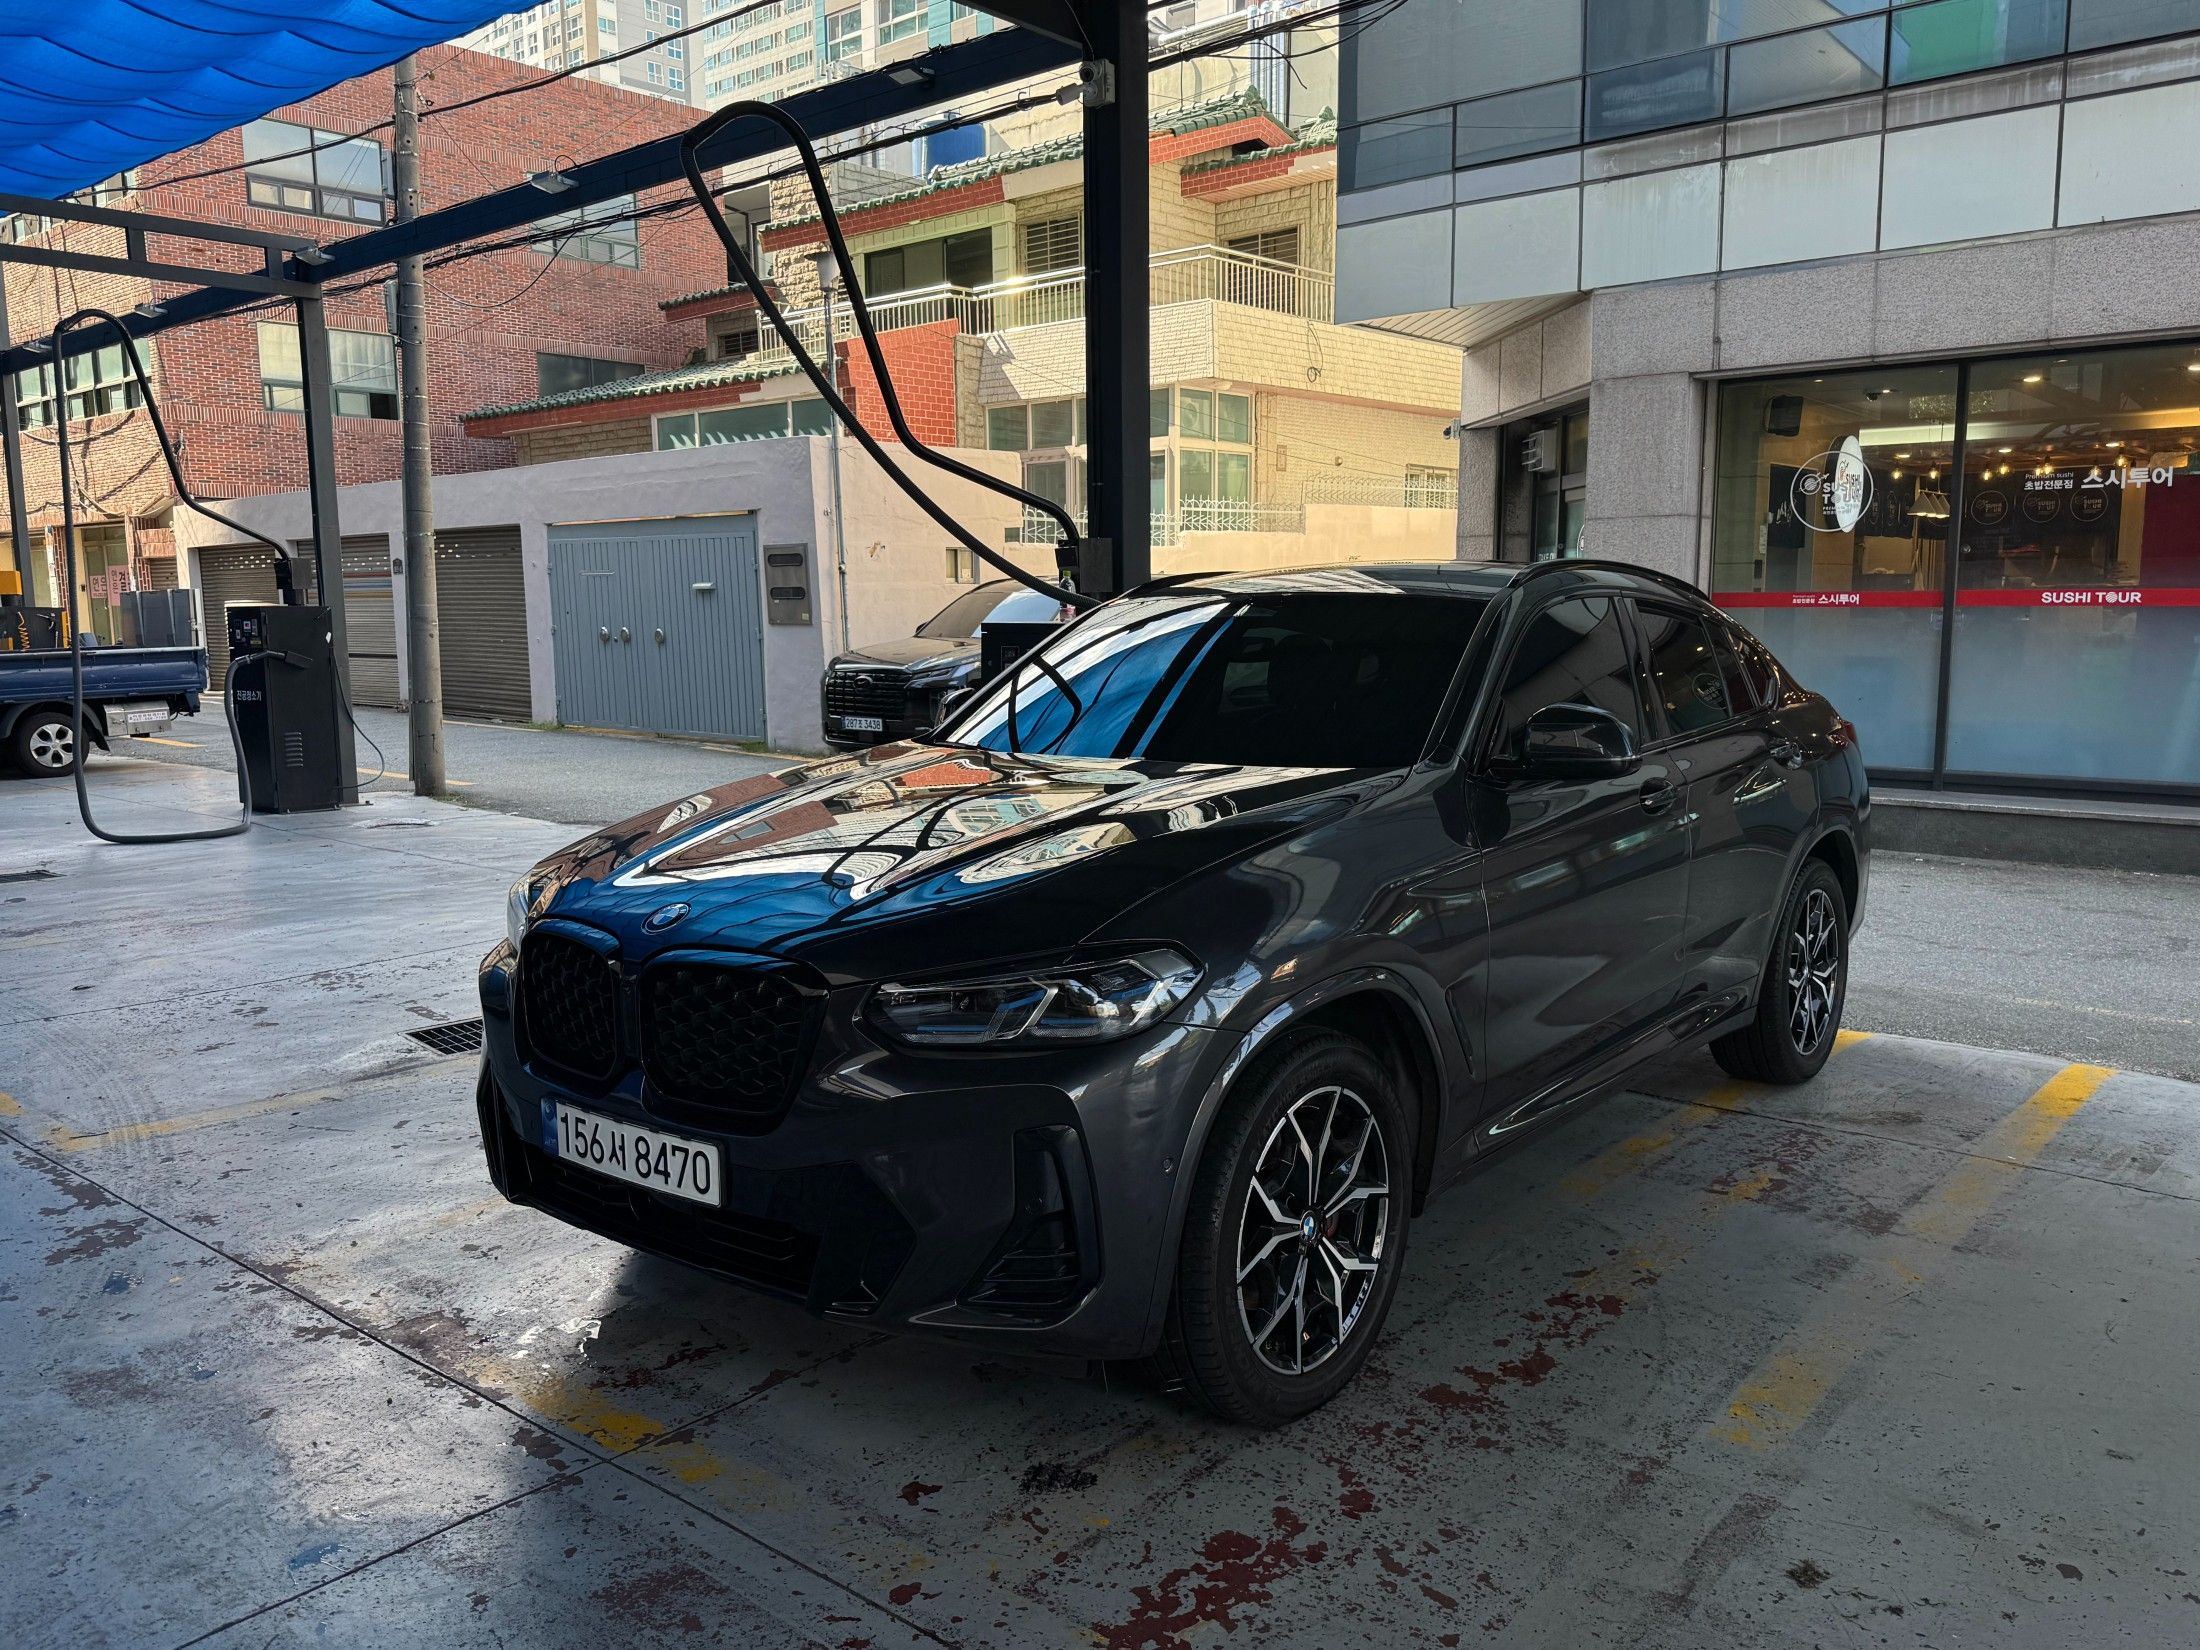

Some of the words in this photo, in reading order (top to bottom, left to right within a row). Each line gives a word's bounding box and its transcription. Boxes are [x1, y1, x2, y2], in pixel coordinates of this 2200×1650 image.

[2056, 471, 2074, 479] sushi
[2081, 465, 2174, 489] 스시투어
[2024, 479, 2074, 491] 초밥전문점
[1818, 593, 1860, 605] 스시투어
[2041, 591, 2091, 604] SUSHI
[2095, 591, 2142, 604] TOUR
[560, 1112, 627, 1171] 156서
[634, 1135, 711, 1195] 8470
